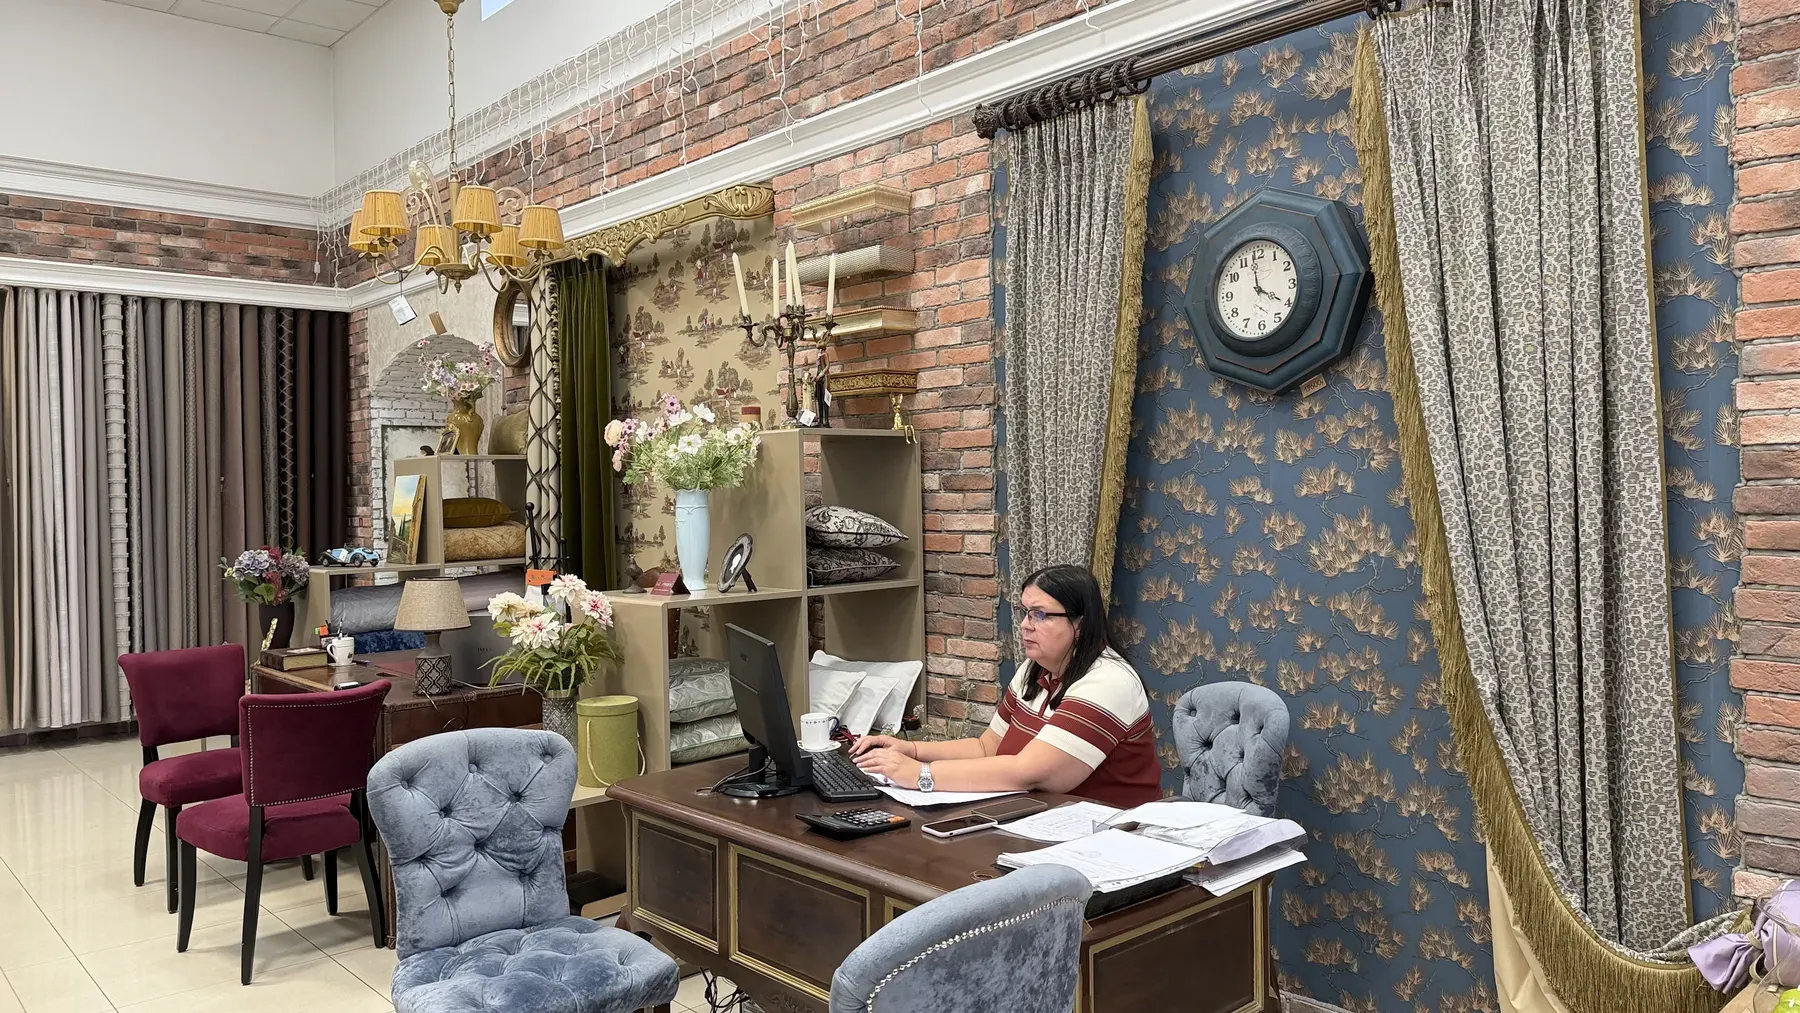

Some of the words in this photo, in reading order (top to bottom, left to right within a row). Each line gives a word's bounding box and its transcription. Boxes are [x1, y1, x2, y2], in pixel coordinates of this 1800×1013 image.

[1252, 248, 1265, 261] 12
[1272, 250, 1278, 262] 1
[1240, 257, 1248, 269] 11
[1283, 261, 1292, 272] 2
[1229, 272, 1240, 284] 10
[1288, 278, 1297, 290] 3
[1225, 291, 1234, 302] 9
[1284, 297, 1293, 308] 4
[1231, 307, 1239, 318] 8
[1273, 312, 1282, 323] 5
[1242, 317, 1251, 329] 7
[1257, 320, 1266, 331] 6
